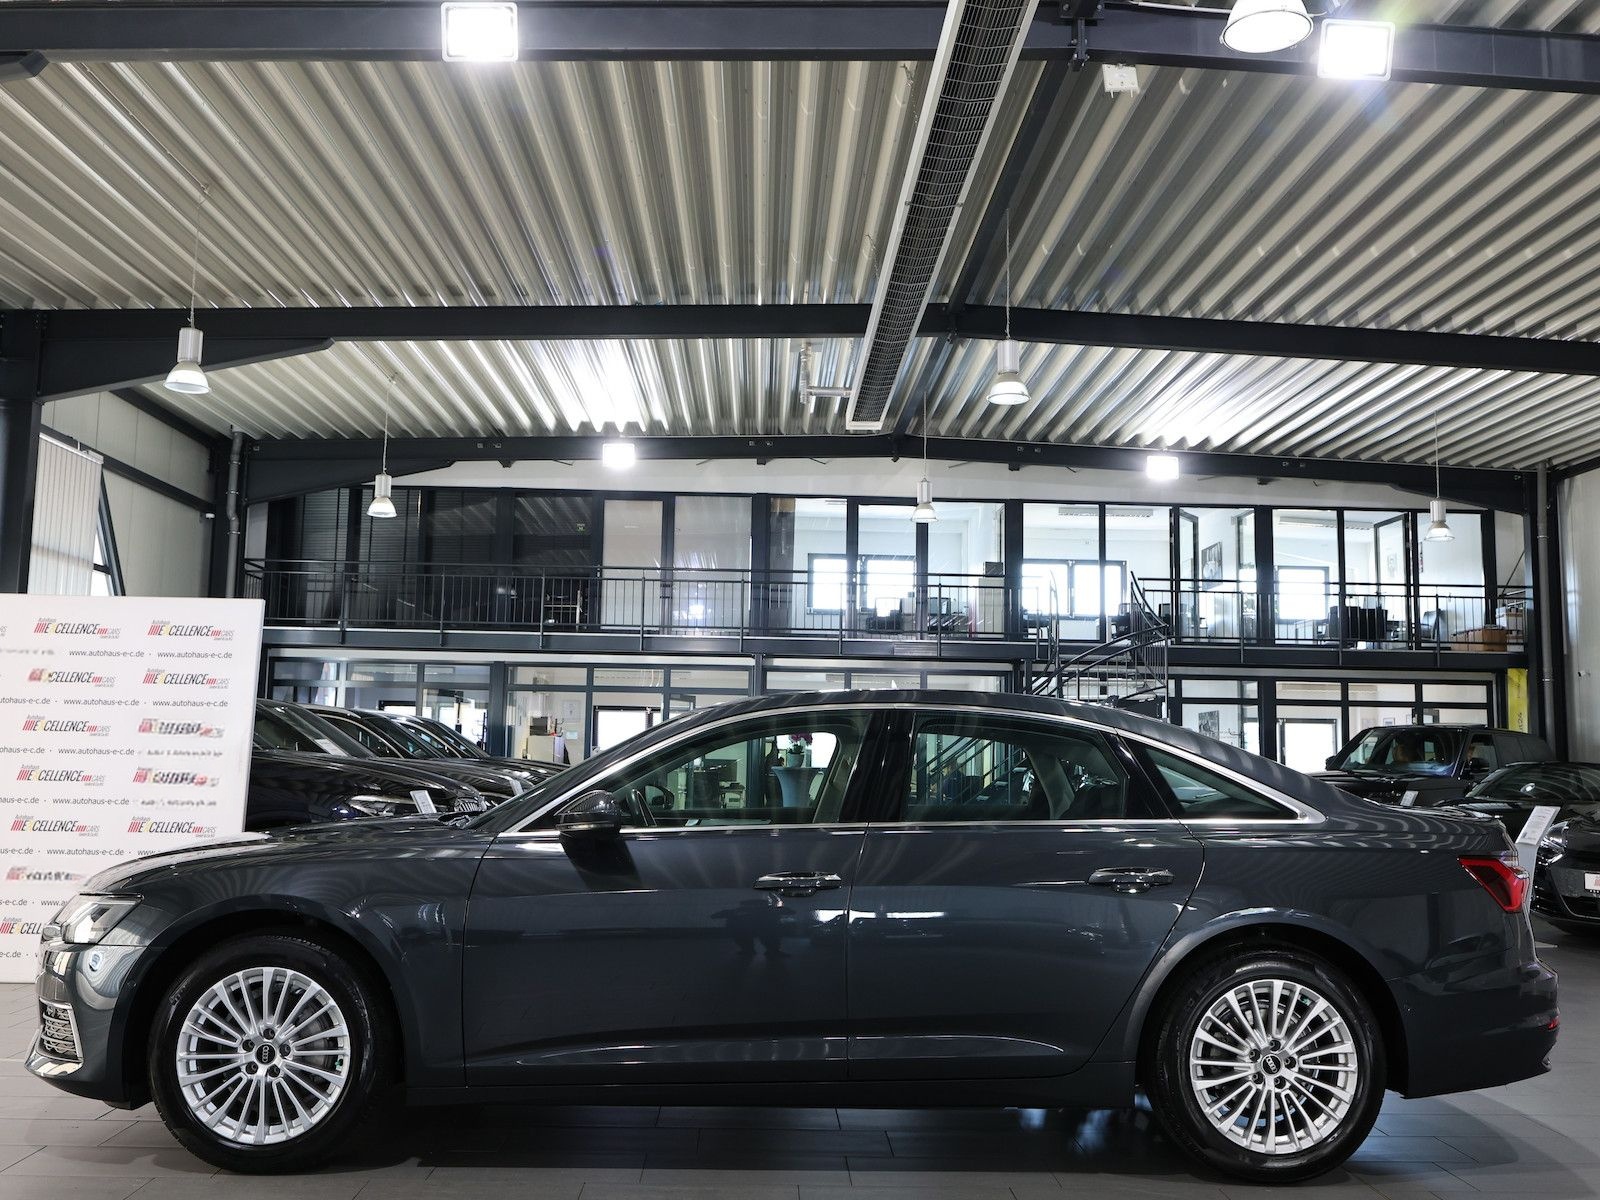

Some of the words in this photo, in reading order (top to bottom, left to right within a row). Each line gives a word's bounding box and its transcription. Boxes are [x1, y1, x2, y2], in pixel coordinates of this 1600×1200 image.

[69, 649, 145, 658] www.autohaus-e-c.de
[157, 650, 233, 659] www.autohaus-e-c.de
[63, 697, 140, 706] www.autohaus-e-c.de
[152, 699, 228, 708] www.autohaus-e-c.de
[58, 746, 135, 756] www.autohaus-e-c.de
[52, 796, 130, 806] www.autohaus-e-c.de
[46, 847, 125, 856] www.autohaus-e-c.de
